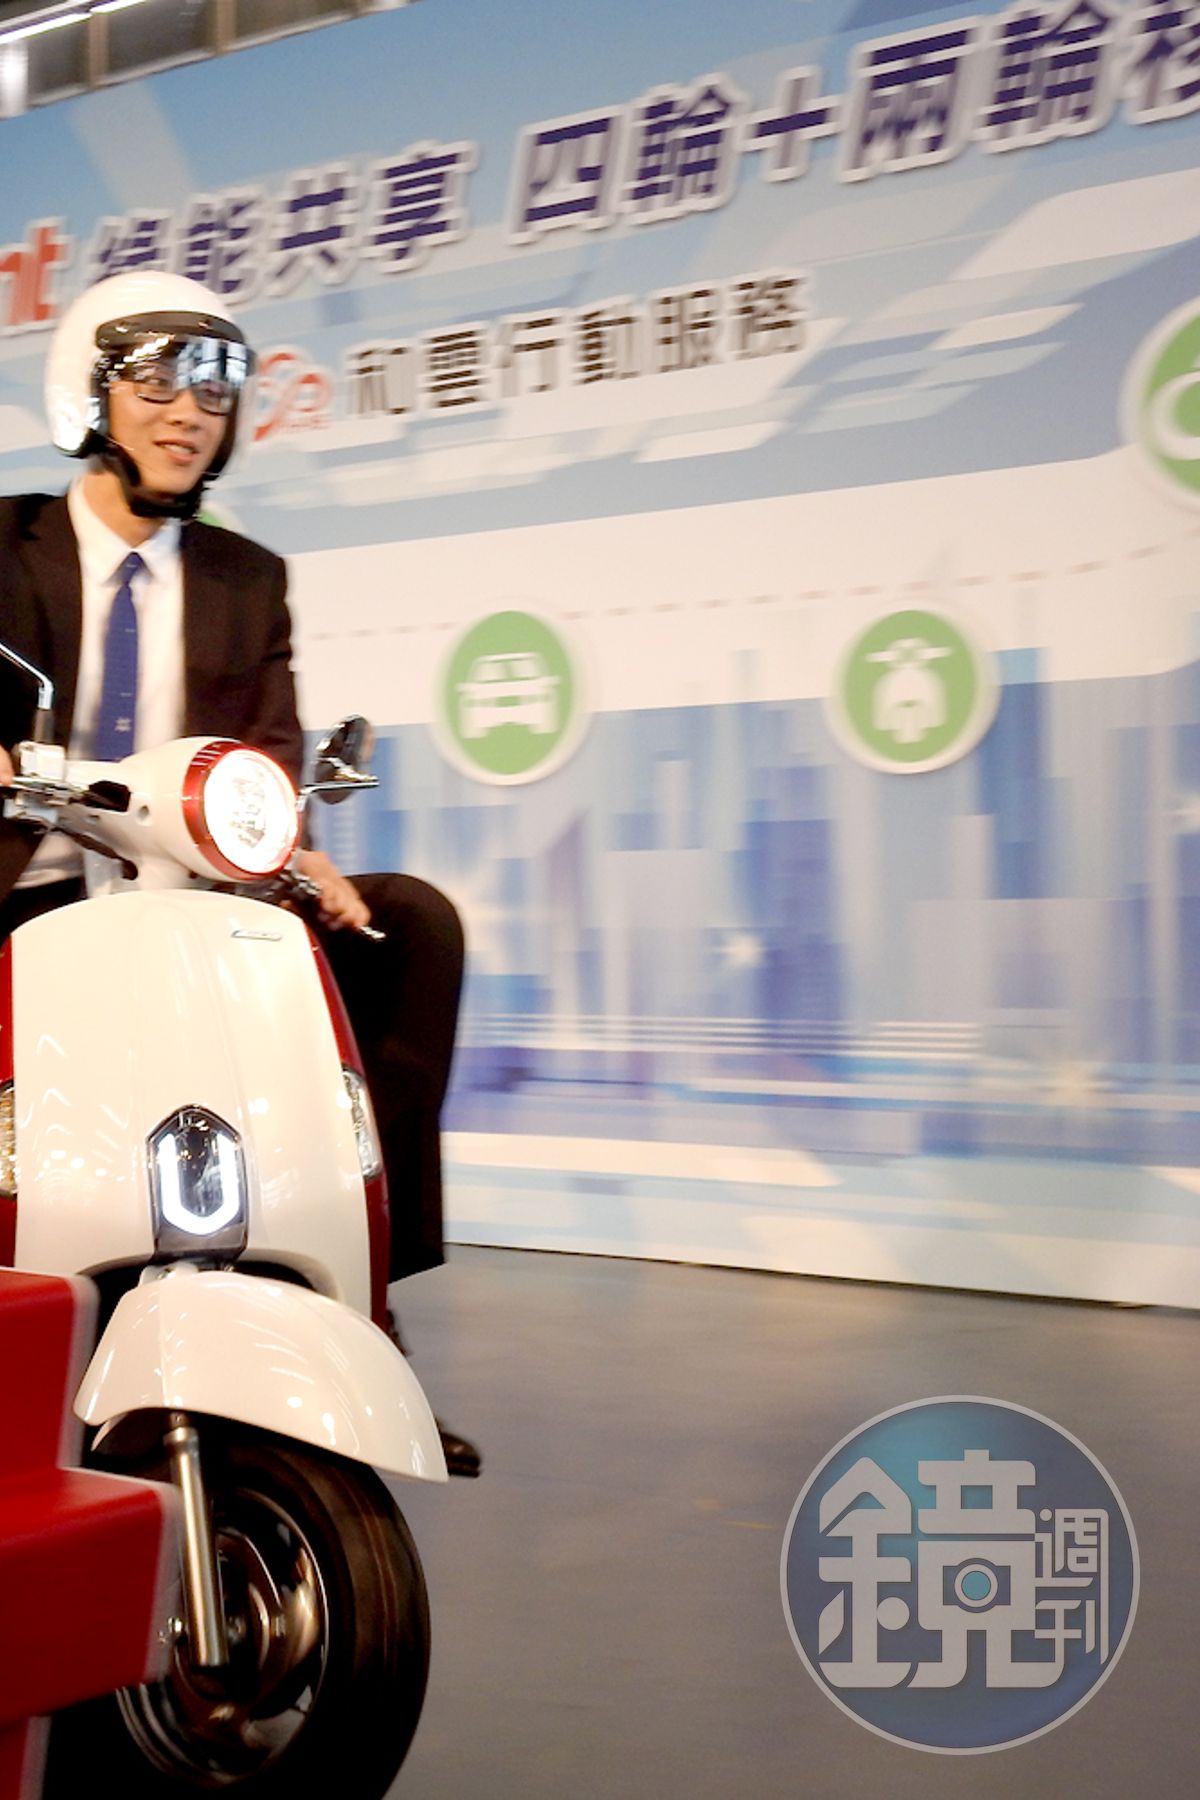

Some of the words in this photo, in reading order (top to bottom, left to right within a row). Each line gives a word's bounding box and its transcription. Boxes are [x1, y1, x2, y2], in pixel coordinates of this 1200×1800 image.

[346, 276, 806, 416] 和雲行動服務
